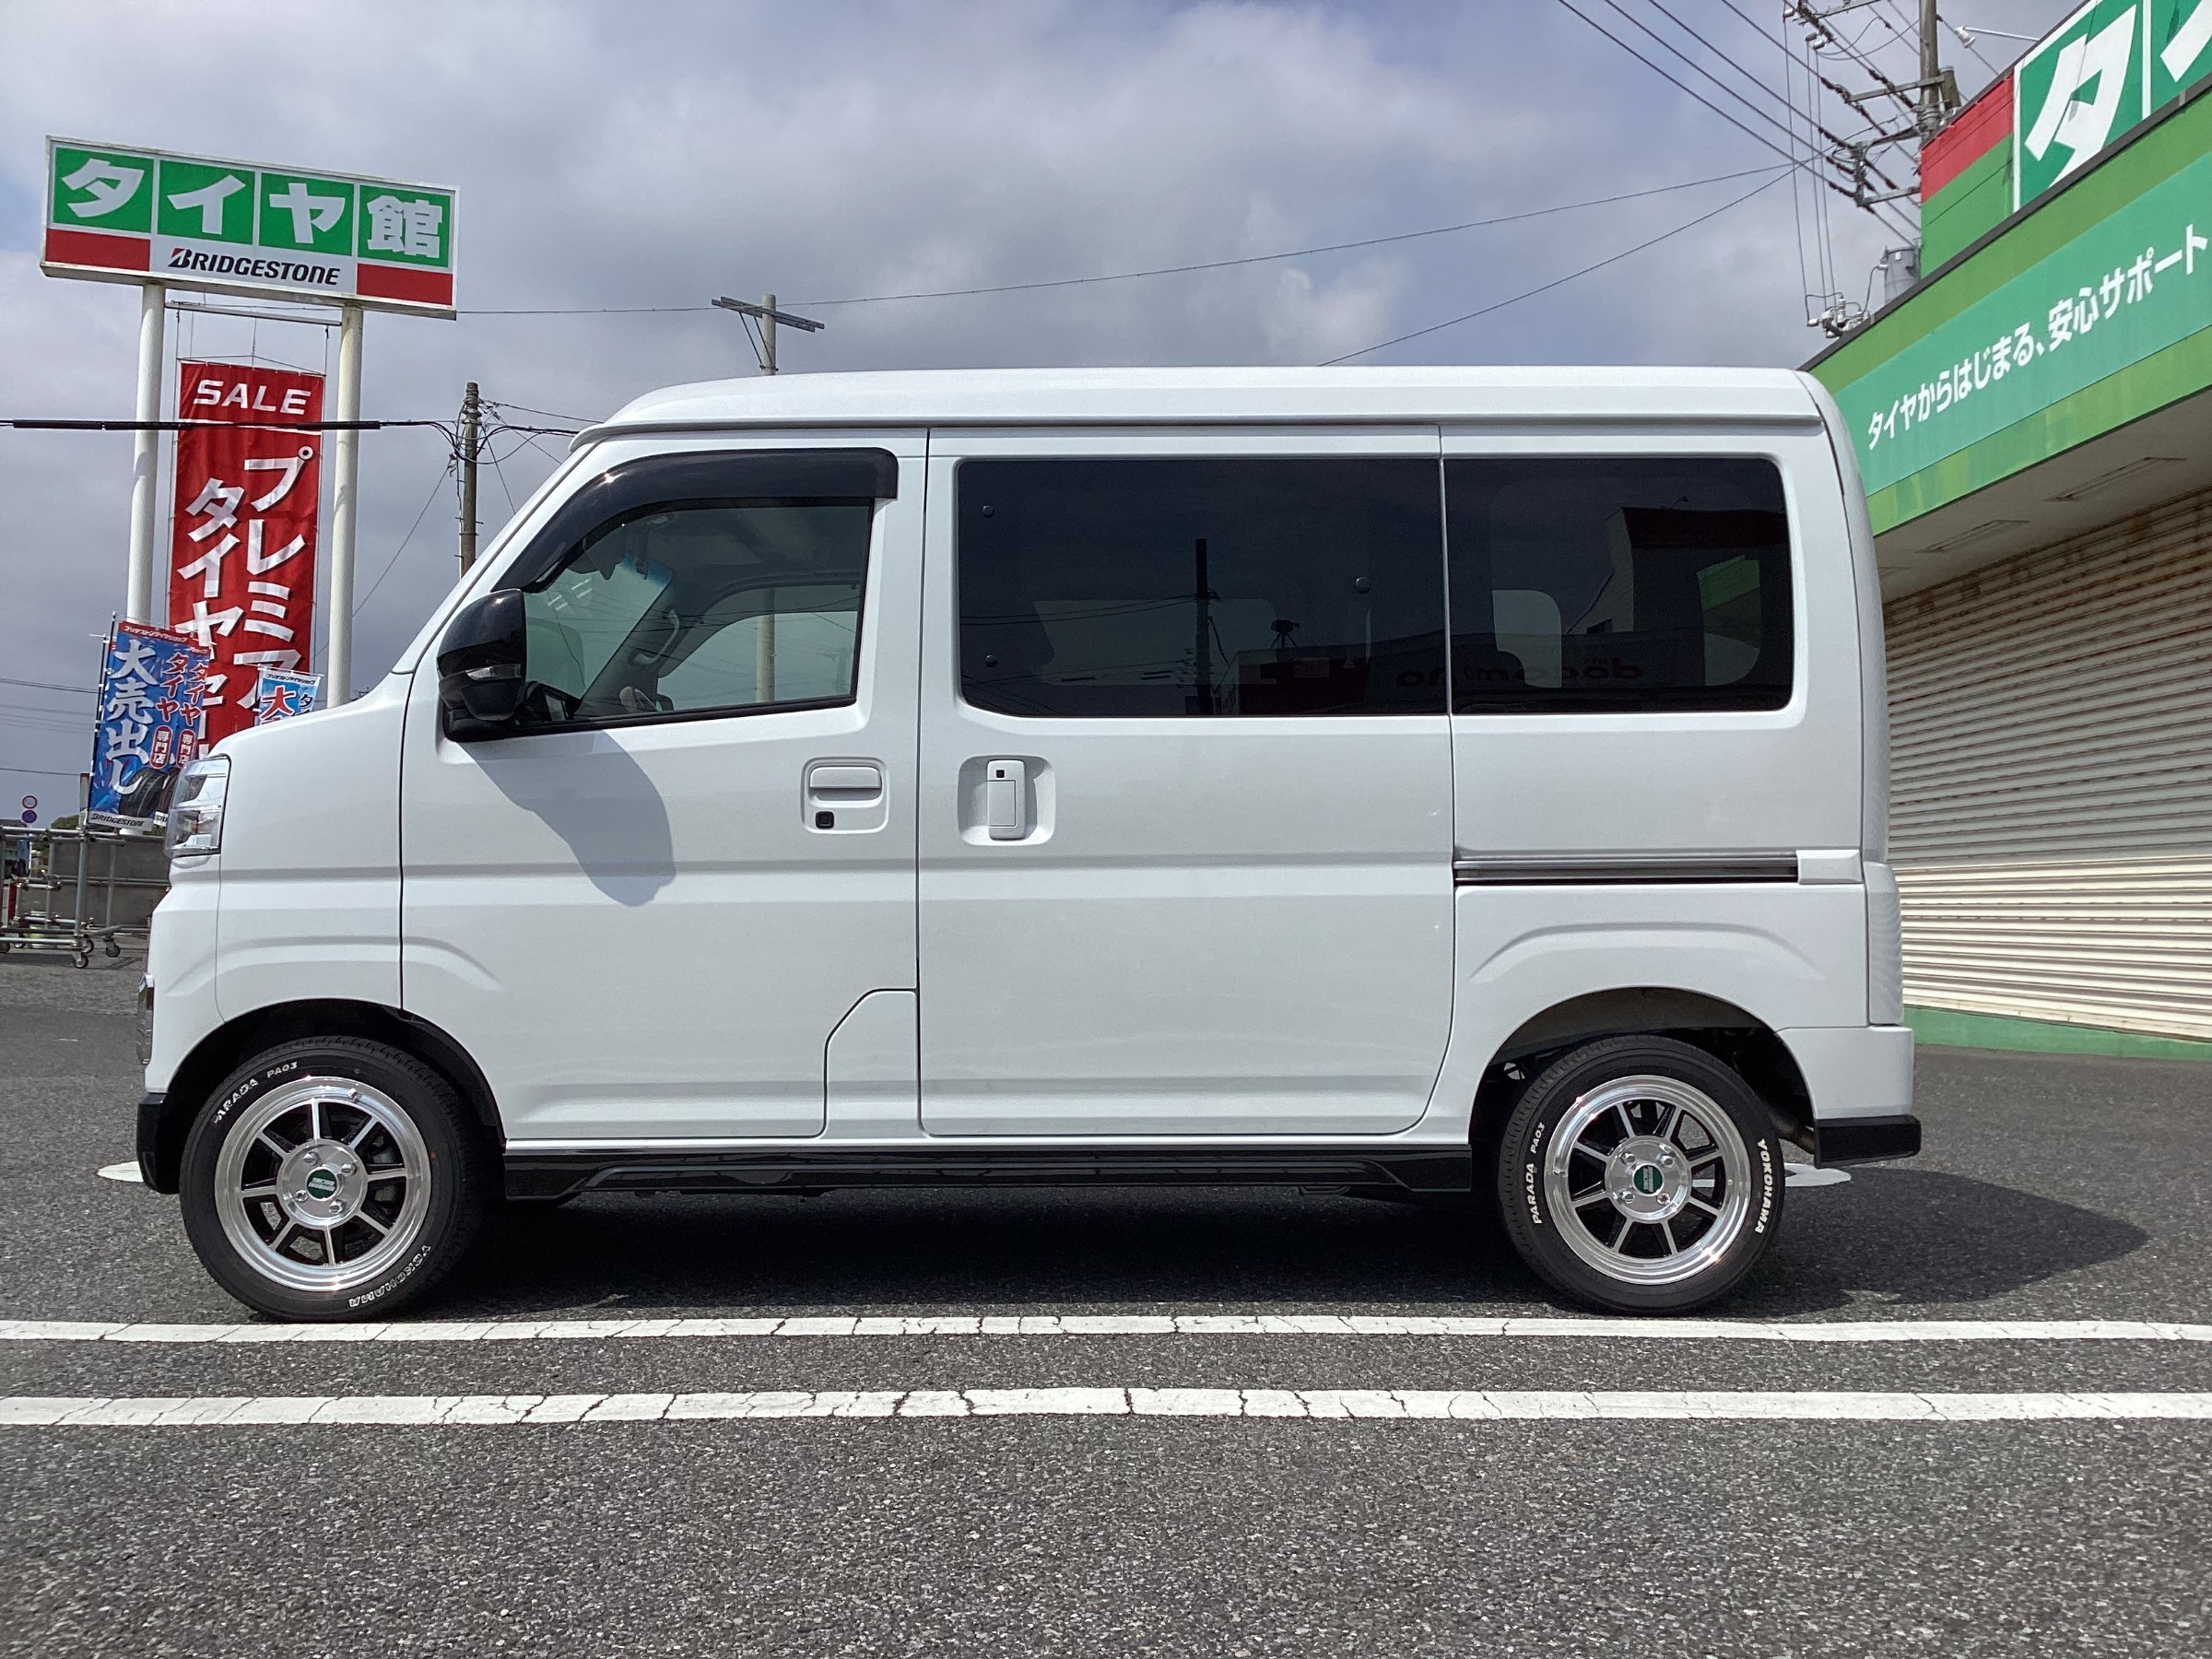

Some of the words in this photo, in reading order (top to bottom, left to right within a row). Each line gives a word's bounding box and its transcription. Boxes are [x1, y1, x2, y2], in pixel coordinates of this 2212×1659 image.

[2025, 0, 2212, 189] タ
[62, 158, 442, 259] タイヤ館
[168, 247, 341, 286] BRIDGESTONE
[1867, 223, 2208, 451] タイヤからはじまる、安心サポート
[193, 379, 312, 415] SALE
[106, 640, 159, 794] 大売出し
[154, 652, 189, 723] タイヤ
[179, 663, 208, 726] タイヤ
[259, 685, 297, 725] 大
[152, 731, 170, 764] 専門店
[90, 812, 145, 828] BRIDGESTONE
[211, 1077, 259, 1124] PARADA
[266, 1061, 298, 1078] PA03
[1530, 1122, 1546, 1154] PA03
[1525, 1163, 1543, 1224] PARADA
[1755, 1138, 1773, 1234] YOKOHAMA
[348, 1244, 431, 1307] YOKOHAMA
